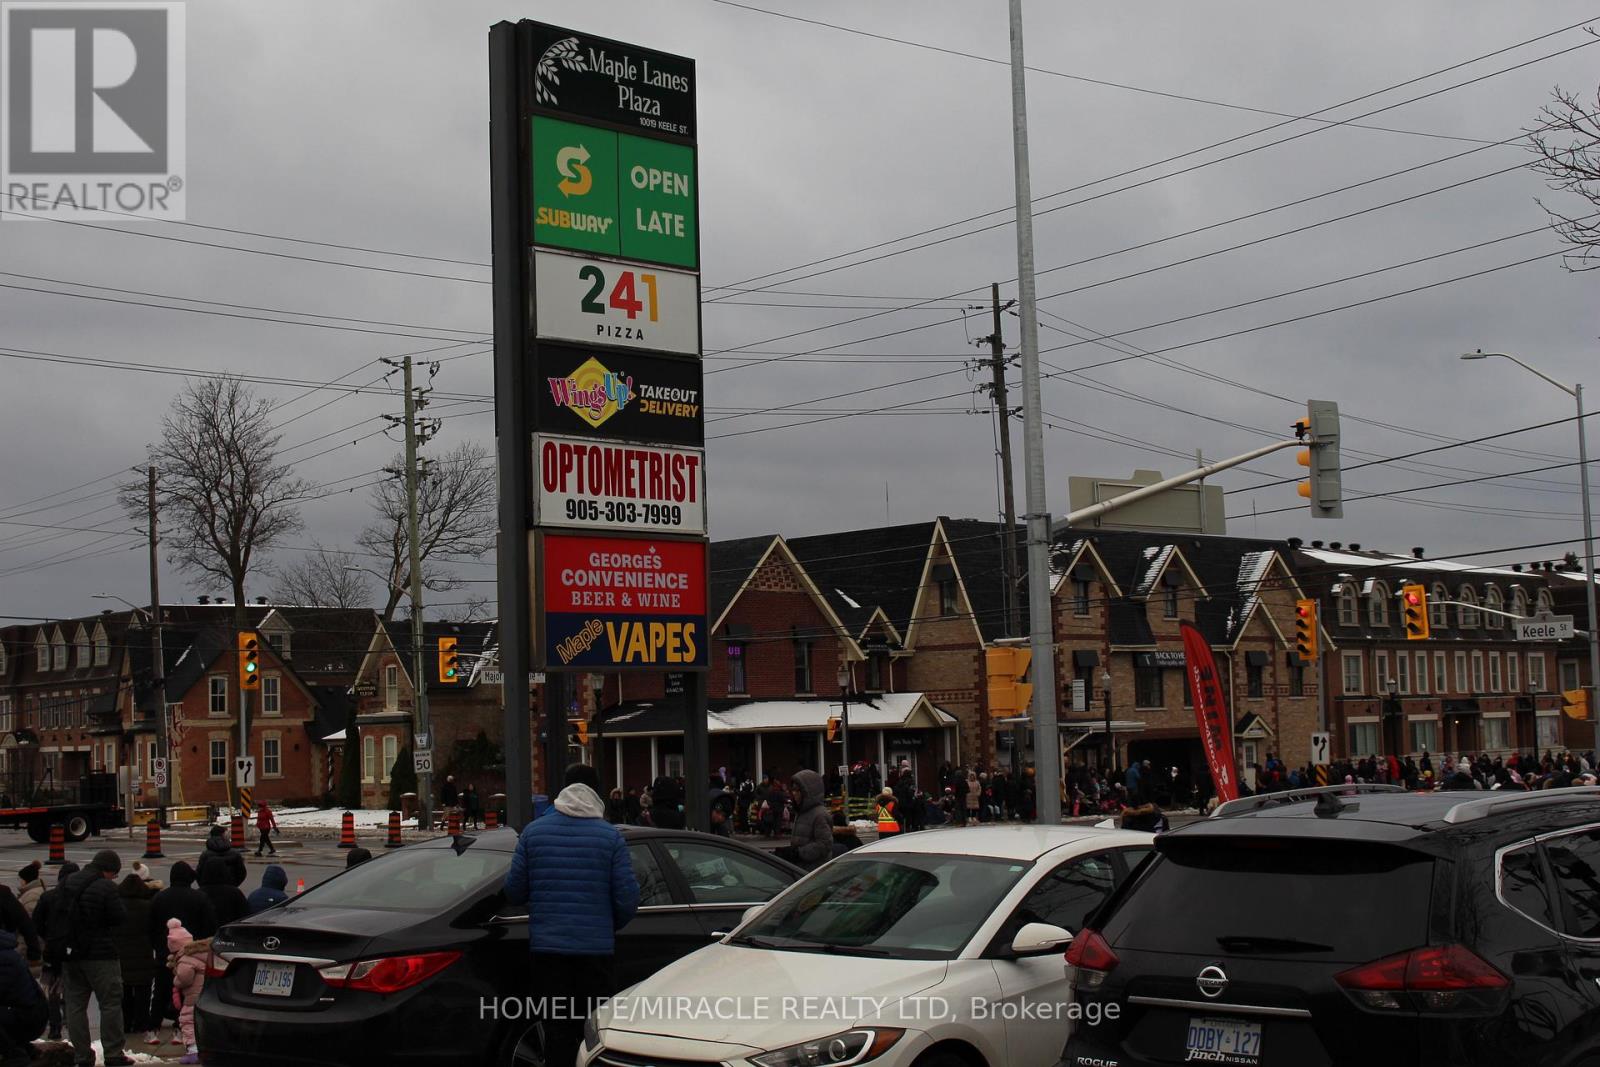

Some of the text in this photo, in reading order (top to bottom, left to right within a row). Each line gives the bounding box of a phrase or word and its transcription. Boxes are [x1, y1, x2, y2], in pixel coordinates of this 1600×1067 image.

[588, 47, 689, 94] Maple Lanes
[617, 85, 661, 116] Plaza
[640, 117, 657, 129] 10019
[658, 121, 678, 133] KEELE
[630, 165, 689, 198] OPEN
[535, 206, 613, 235] SUBWAY
[636, 207, 685, 239] LATE
[578, 265, 658, 322] 241
[596, 324, 644, 341] PIZZA
[639, 400, 700, 418] DELIVERY
[542, 441, 699, 503] OPTOMETRIST
[566, 498, 682, 526] 905-303-7999
[560, 568, 689, 590] CONVENIENCE
[571, 590, 681, 608] BEER & WINE
[554, 617, 697, 665] Maple VAPES
[1522, 624, 1555, 638] Keele
[484, 671, 502, 684] Major
[416, 759, 431, 771] 50
[1185, 1048, 1259, 1065] finch NISSAN
